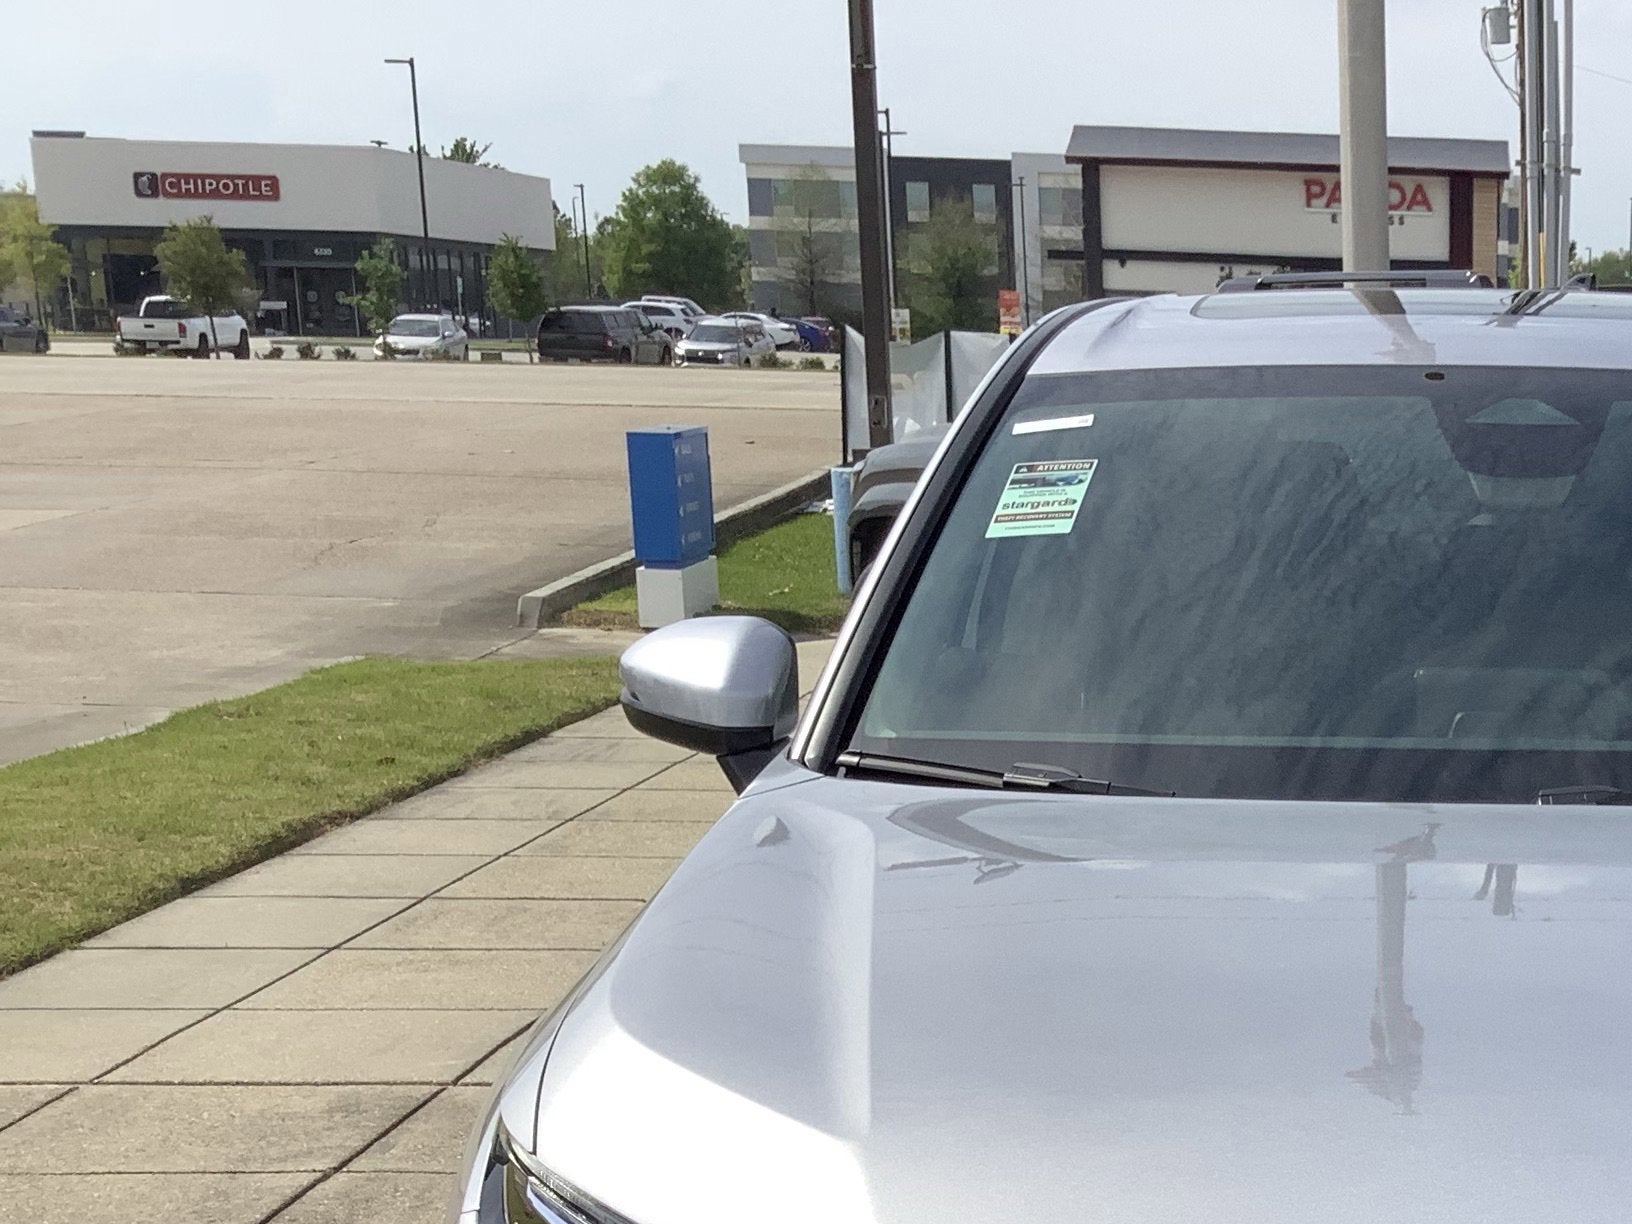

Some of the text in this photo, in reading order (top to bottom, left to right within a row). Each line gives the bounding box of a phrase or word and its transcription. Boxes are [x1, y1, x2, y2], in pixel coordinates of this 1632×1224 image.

[165, 177, 273, 196] CHIPOTLE
[1304, 178, 1433, 212] PADA
[1036, 463, 1091, 472] ATTENTION
[1001, 498, 1069, 510] stargard
